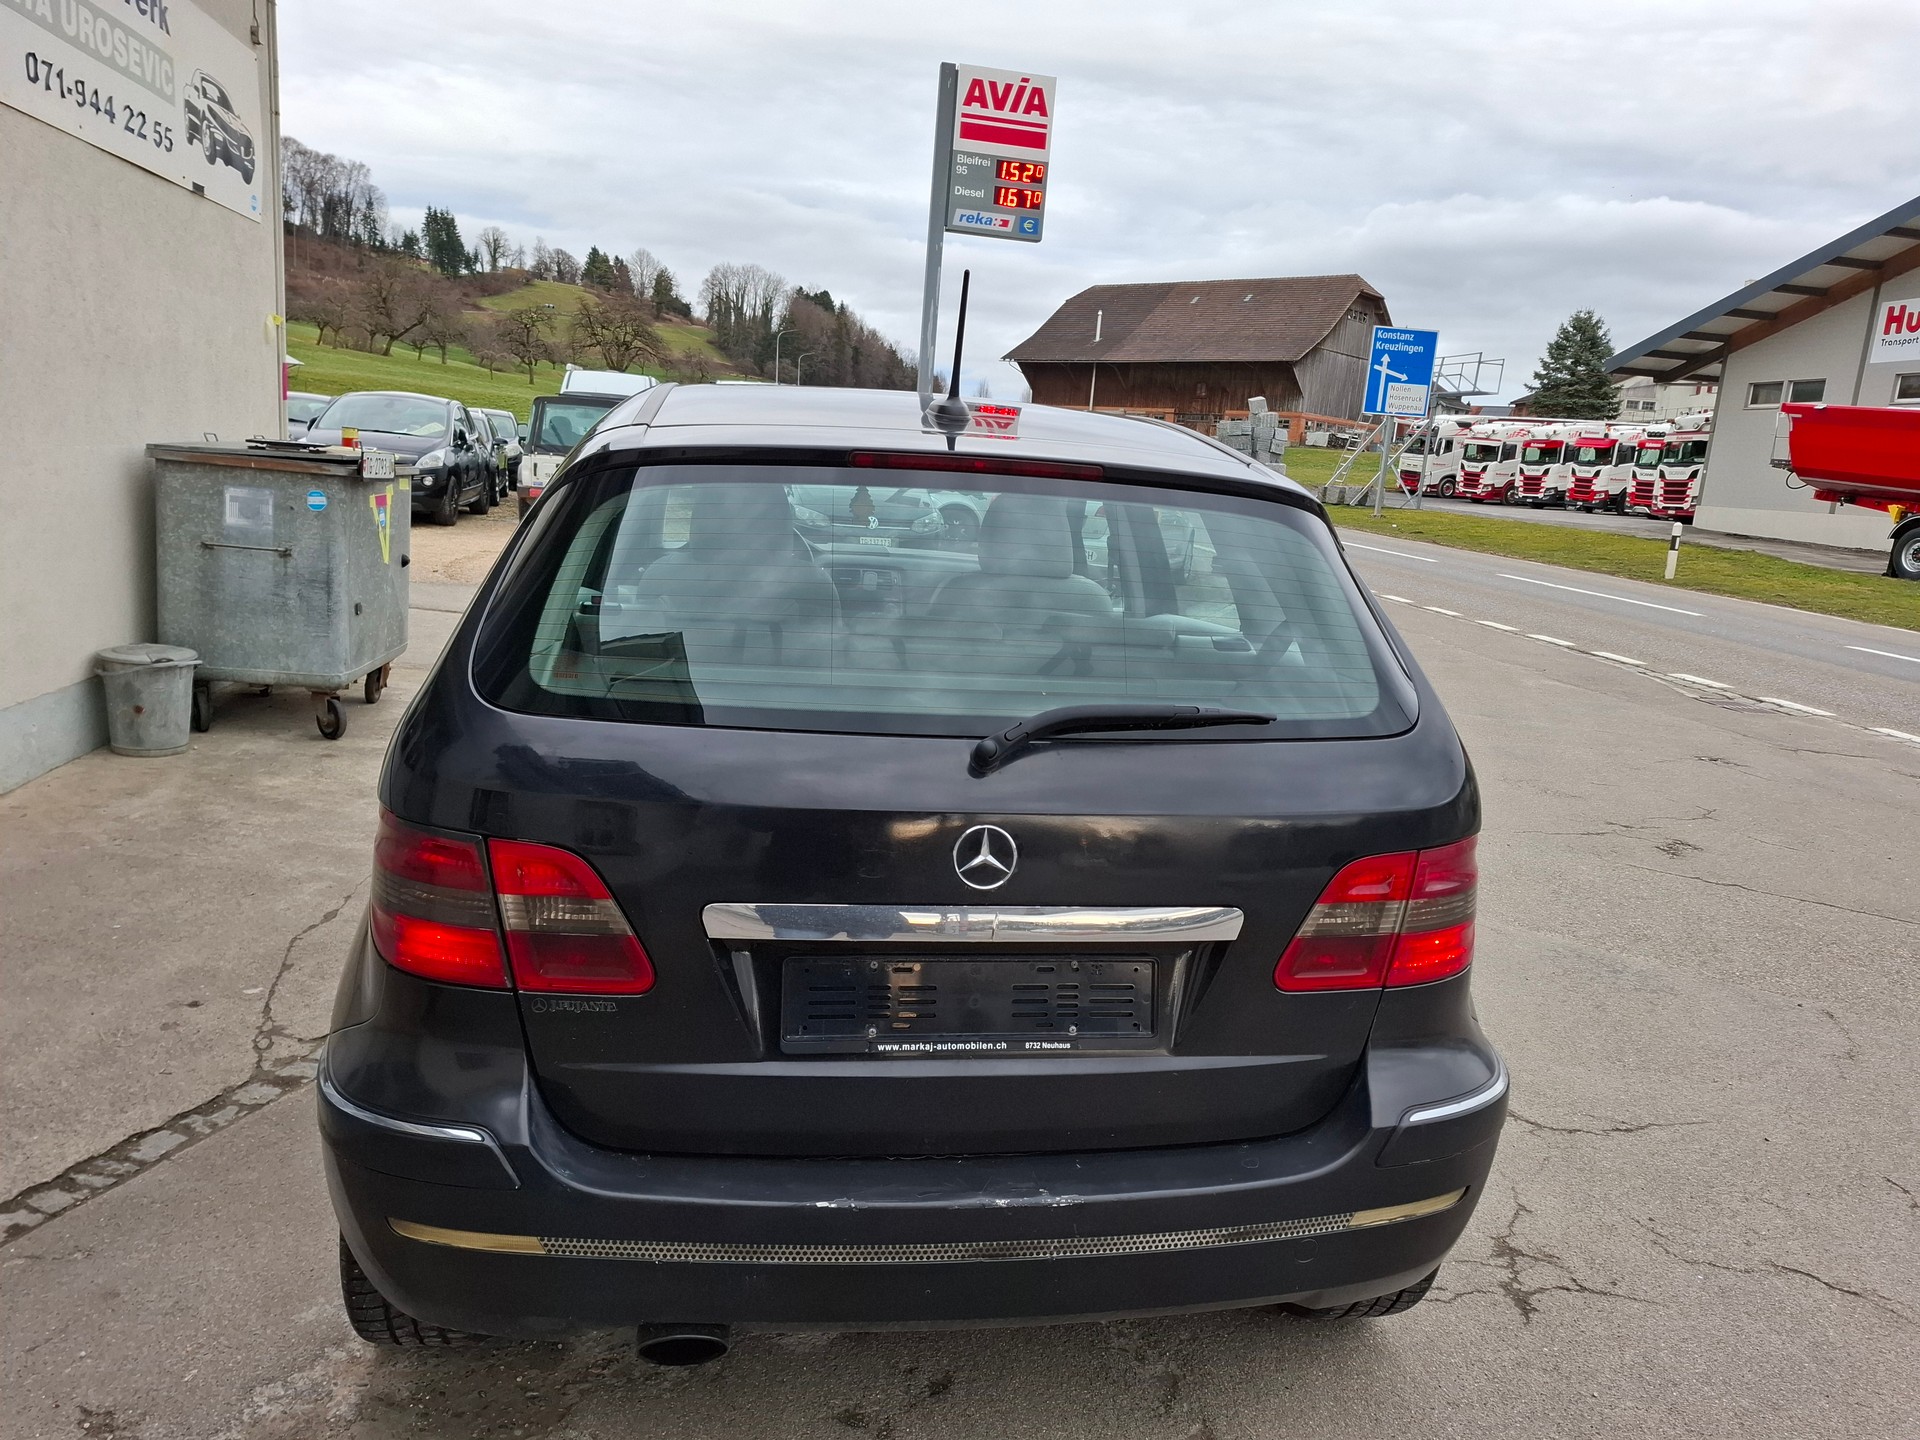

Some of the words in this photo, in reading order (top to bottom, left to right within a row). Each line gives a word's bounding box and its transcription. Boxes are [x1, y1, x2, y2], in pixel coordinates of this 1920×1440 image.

[124, 0, 171, 37] erk
[60, 1, 173, 96] UROSEVIC
[962, 77, 1049, 118] AVIA
[123, 105, 148, 140] 22
[153, 121, 174, 153] 55
[957, 154, 991, 167] Bleifrei
[955, 165, 968, 175] 95
[954, 186, 985, 198] Diesel
[1377, 330, 1414, 341] Konstanz
[1376, 341, 1424, 354] Kreuzlingen
[1882, 337, 1919, 347] Transport
[1390, 385, 1412, 393] Nollen
[1389, 394, 1423, 403] Hosenruck
[1388, 402, 1422, 412] Wuppenau
[877, 1041, 1007, 1052] www.markaj-automobilen.ch
[1041, 1041, 1071, 1049] Neuhaus
